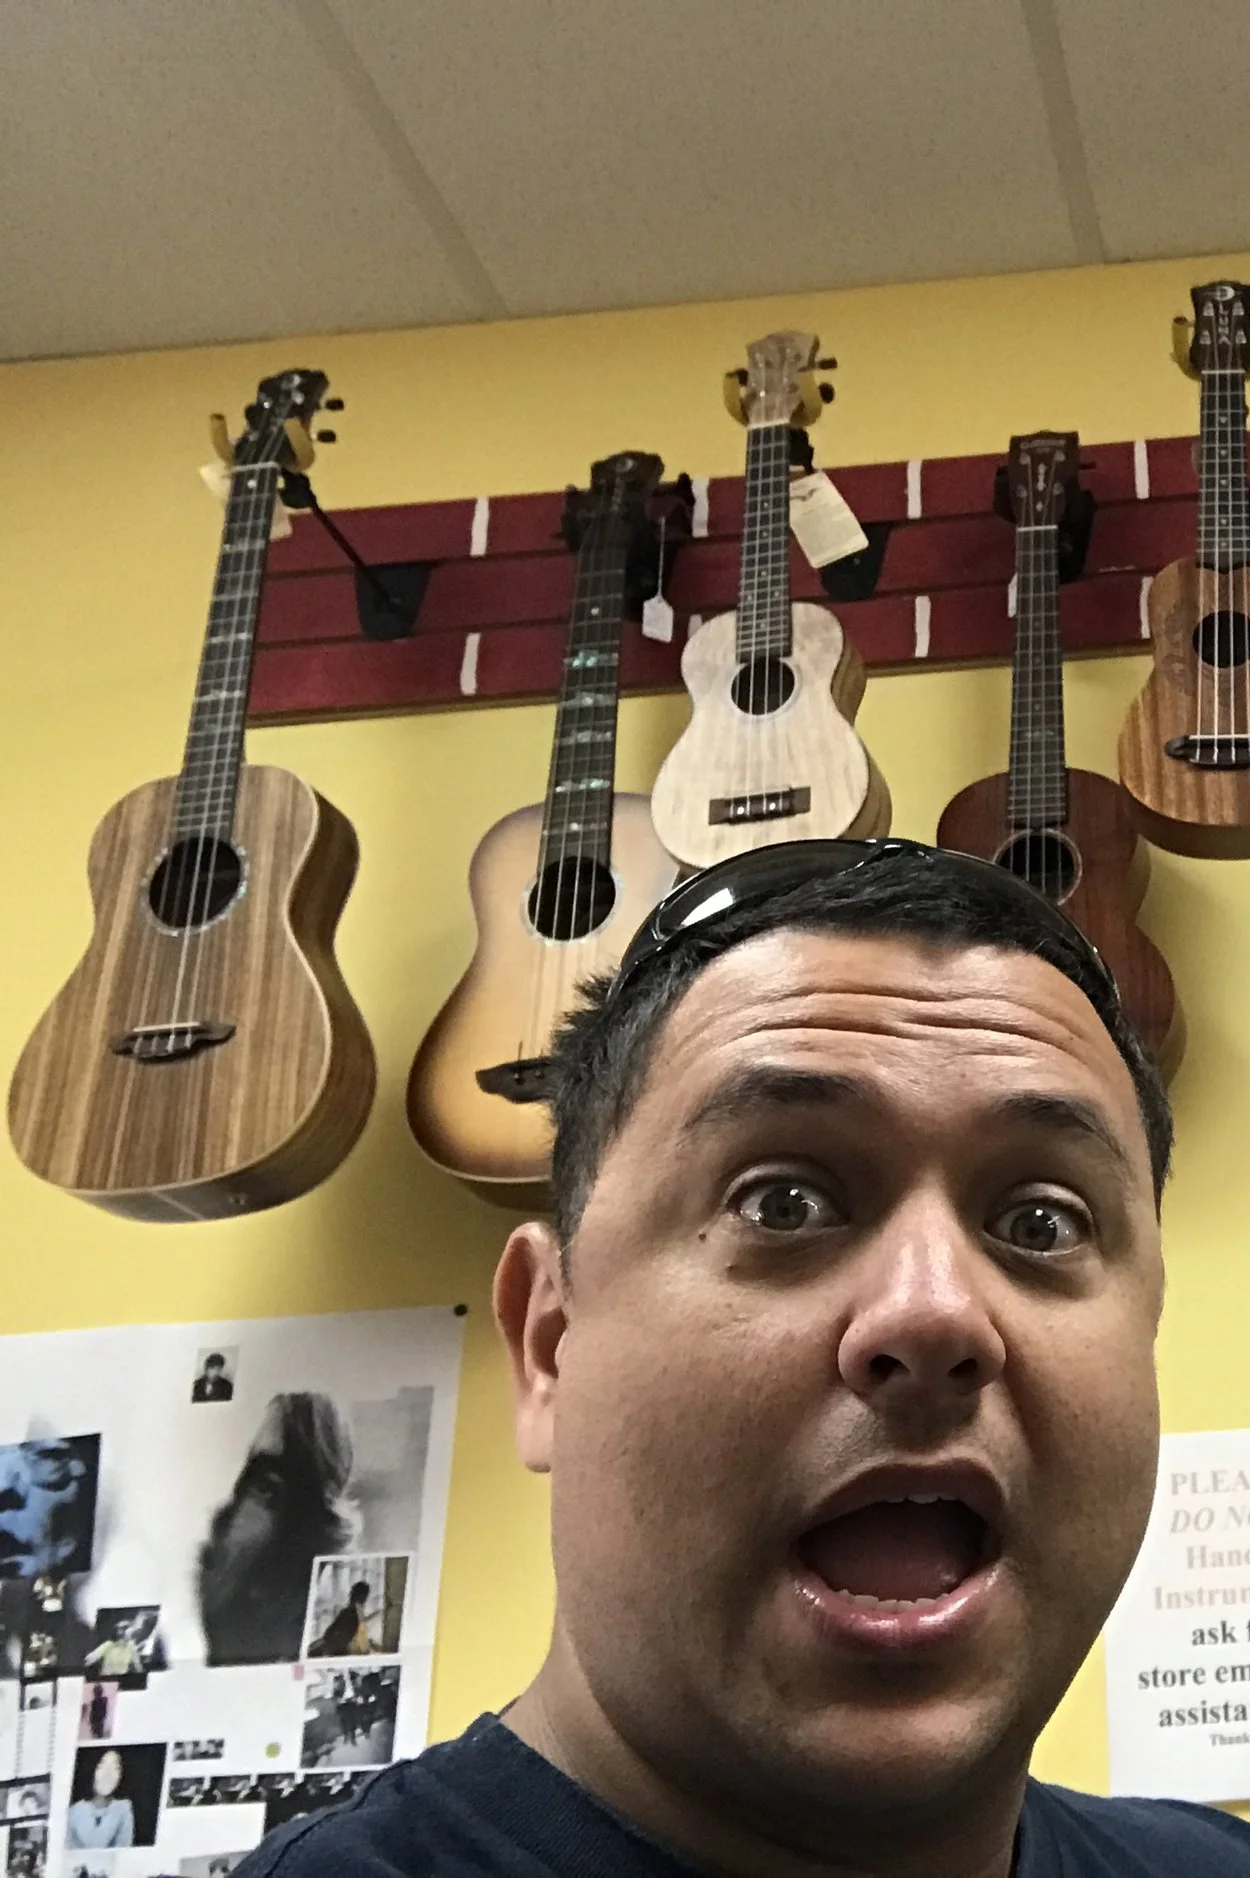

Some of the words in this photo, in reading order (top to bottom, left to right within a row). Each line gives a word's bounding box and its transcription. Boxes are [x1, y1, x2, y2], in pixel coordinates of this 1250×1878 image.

[1169, 1507, 1215, 1535] DO
[1191, 1620, 1237, 1646] ask
[1137, 1663, 1207, 1690] store
